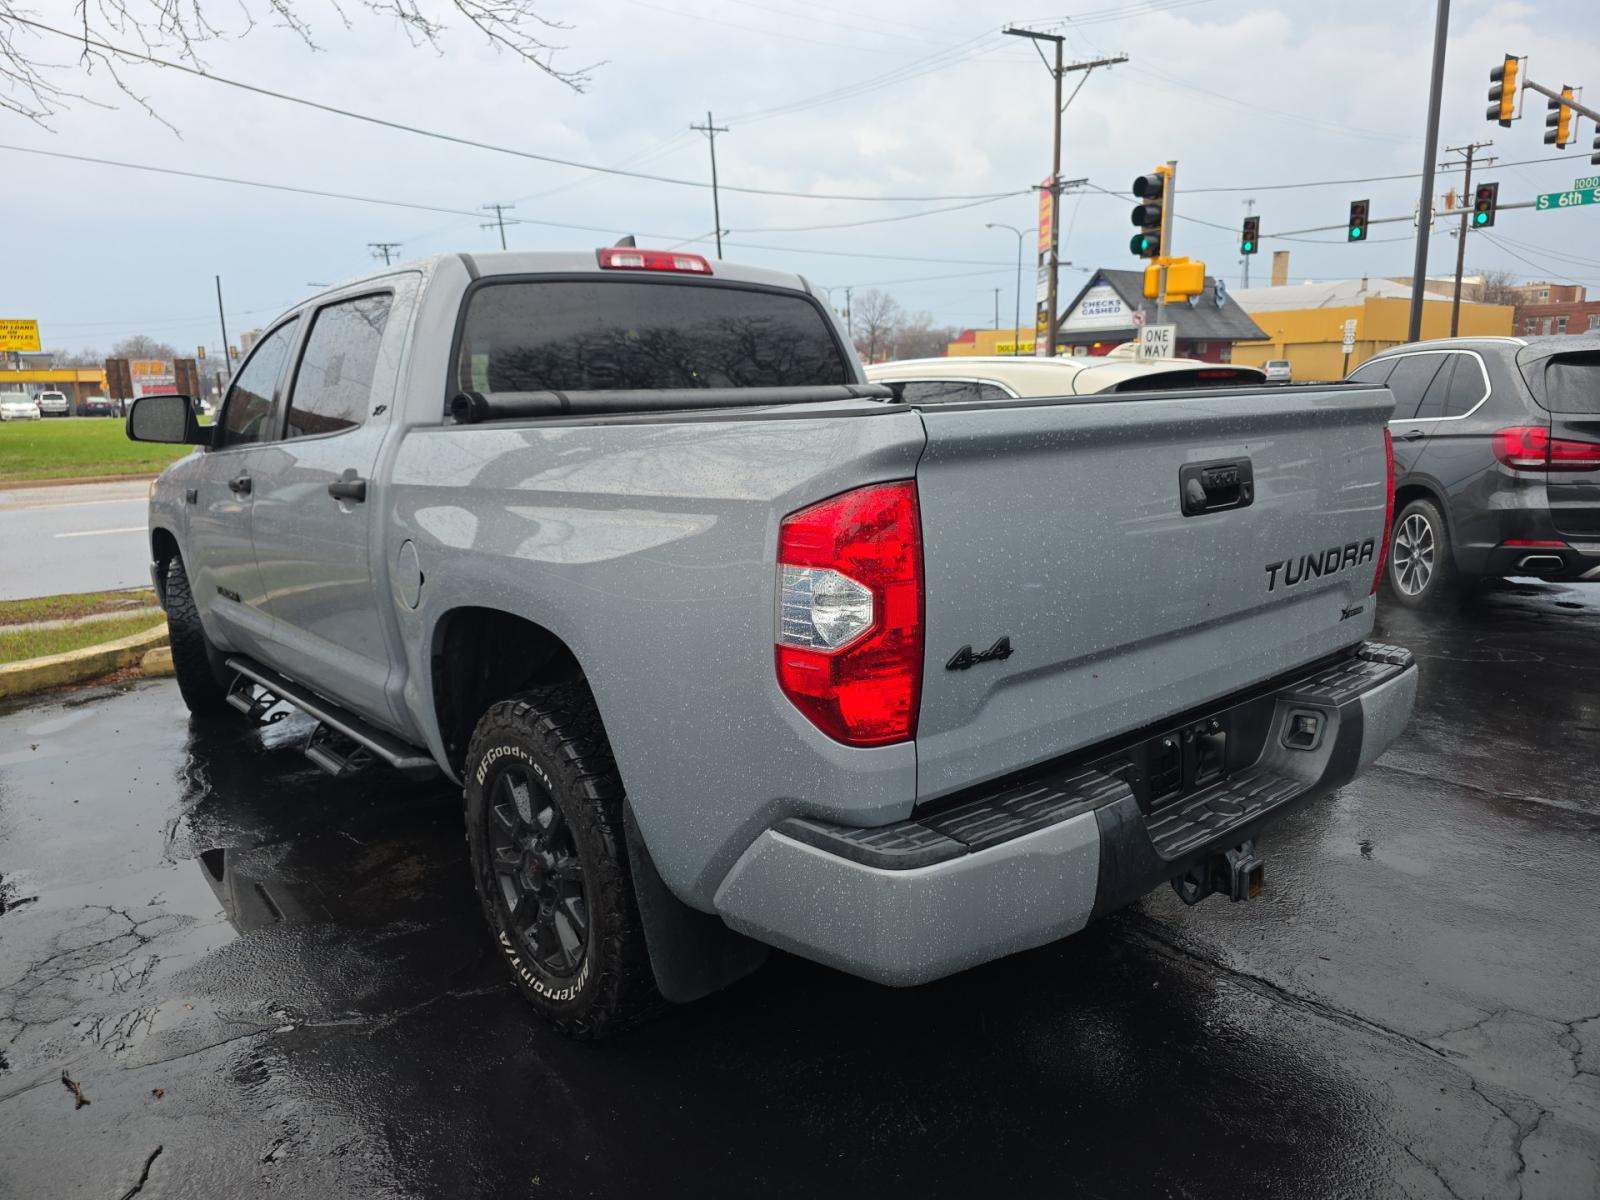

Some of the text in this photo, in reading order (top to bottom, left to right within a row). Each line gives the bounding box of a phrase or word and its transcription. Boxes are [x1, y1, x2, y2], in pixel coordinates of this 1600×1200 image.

[1575, 177, 1599, 189] 1000
[1538, 195, 1549, 209] S
[1558, 191, 1582, 207] 6th
[1082, 299, 1121, 309] CHECKS
[1081, 306, 1121, 316] CASHED
[1146, 329, 1169, 342] ONE
[1144, 343, 1168, 358] WAY
[1264, 536, 1376, 593] TUNDRA
